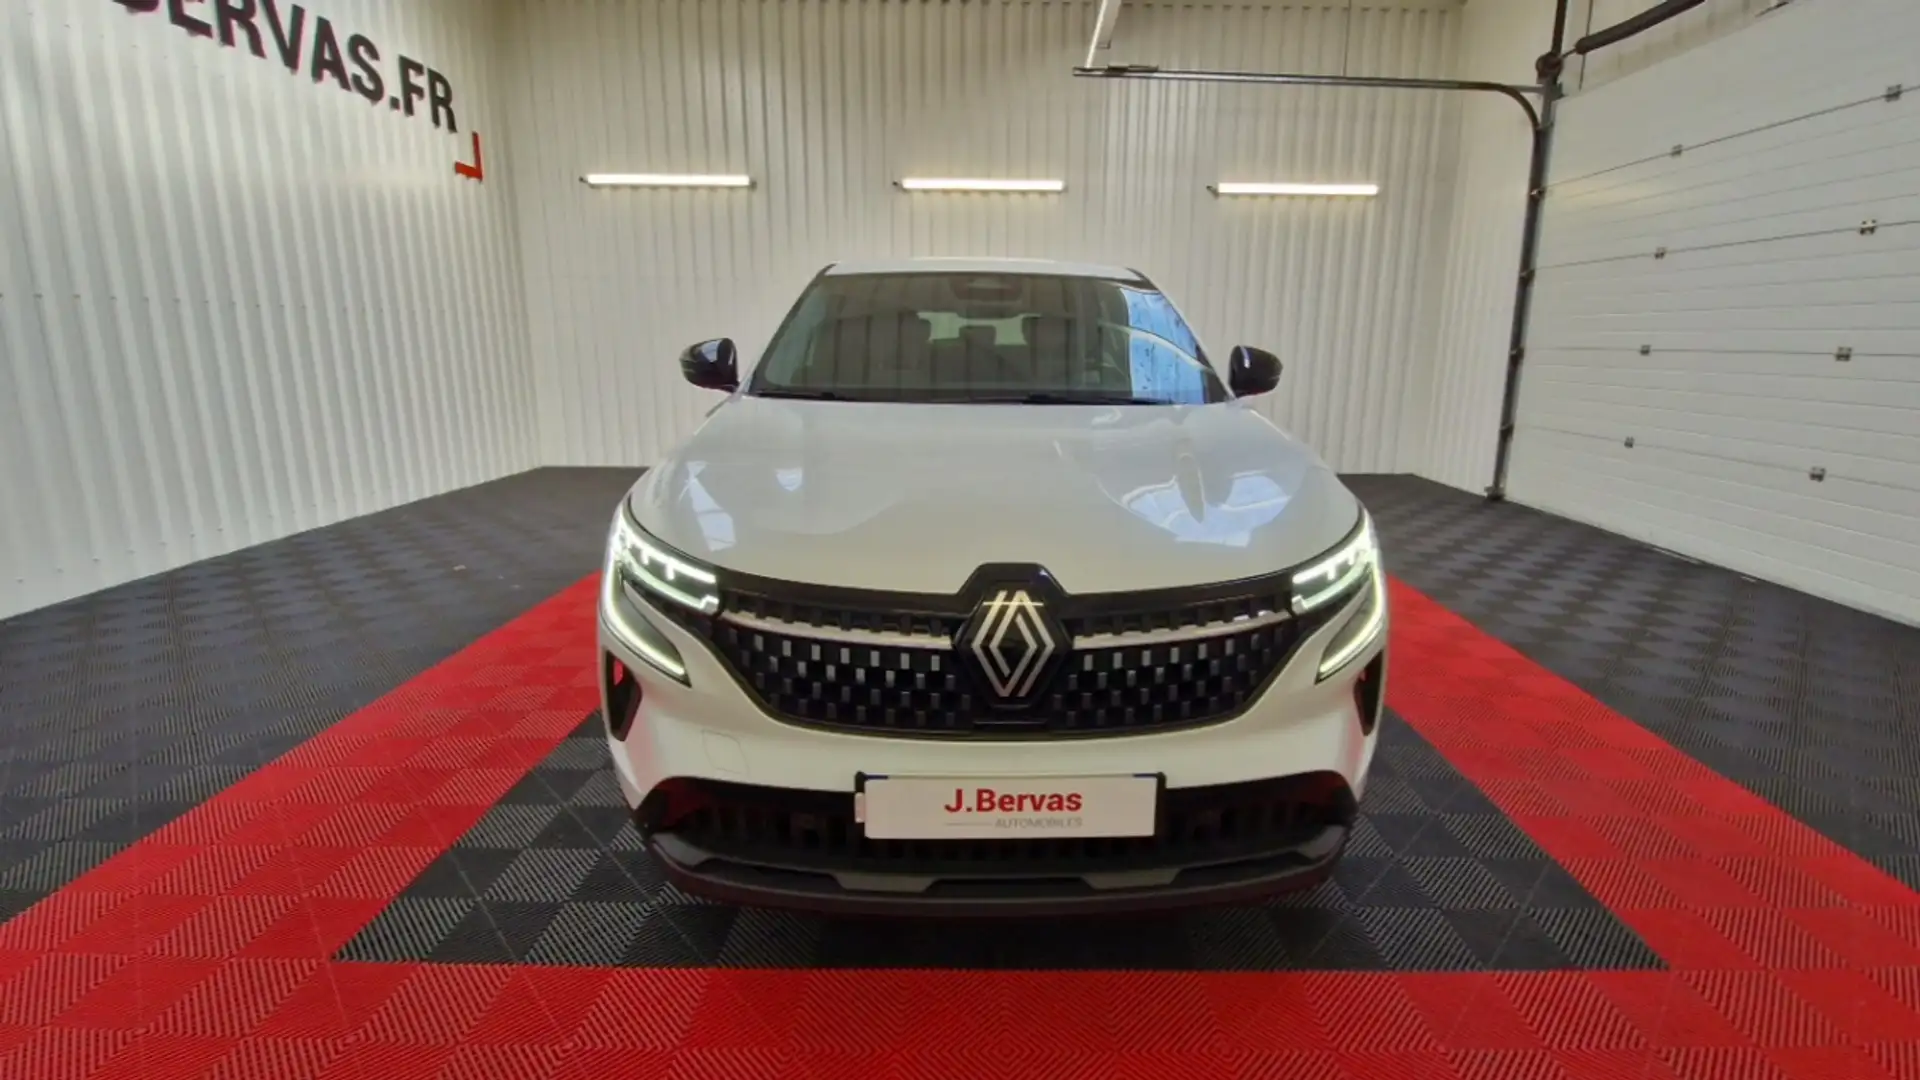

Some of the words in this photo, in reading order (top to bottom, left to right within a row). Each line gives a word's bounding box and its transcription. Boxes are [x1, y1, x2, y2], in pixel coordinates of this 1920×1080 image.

[113, 0, 457, 132] RVAS.FR
[944, 788, 1083, 812] J.Bervas
[995, 817, 1083, 829] AUTOMOBILES
